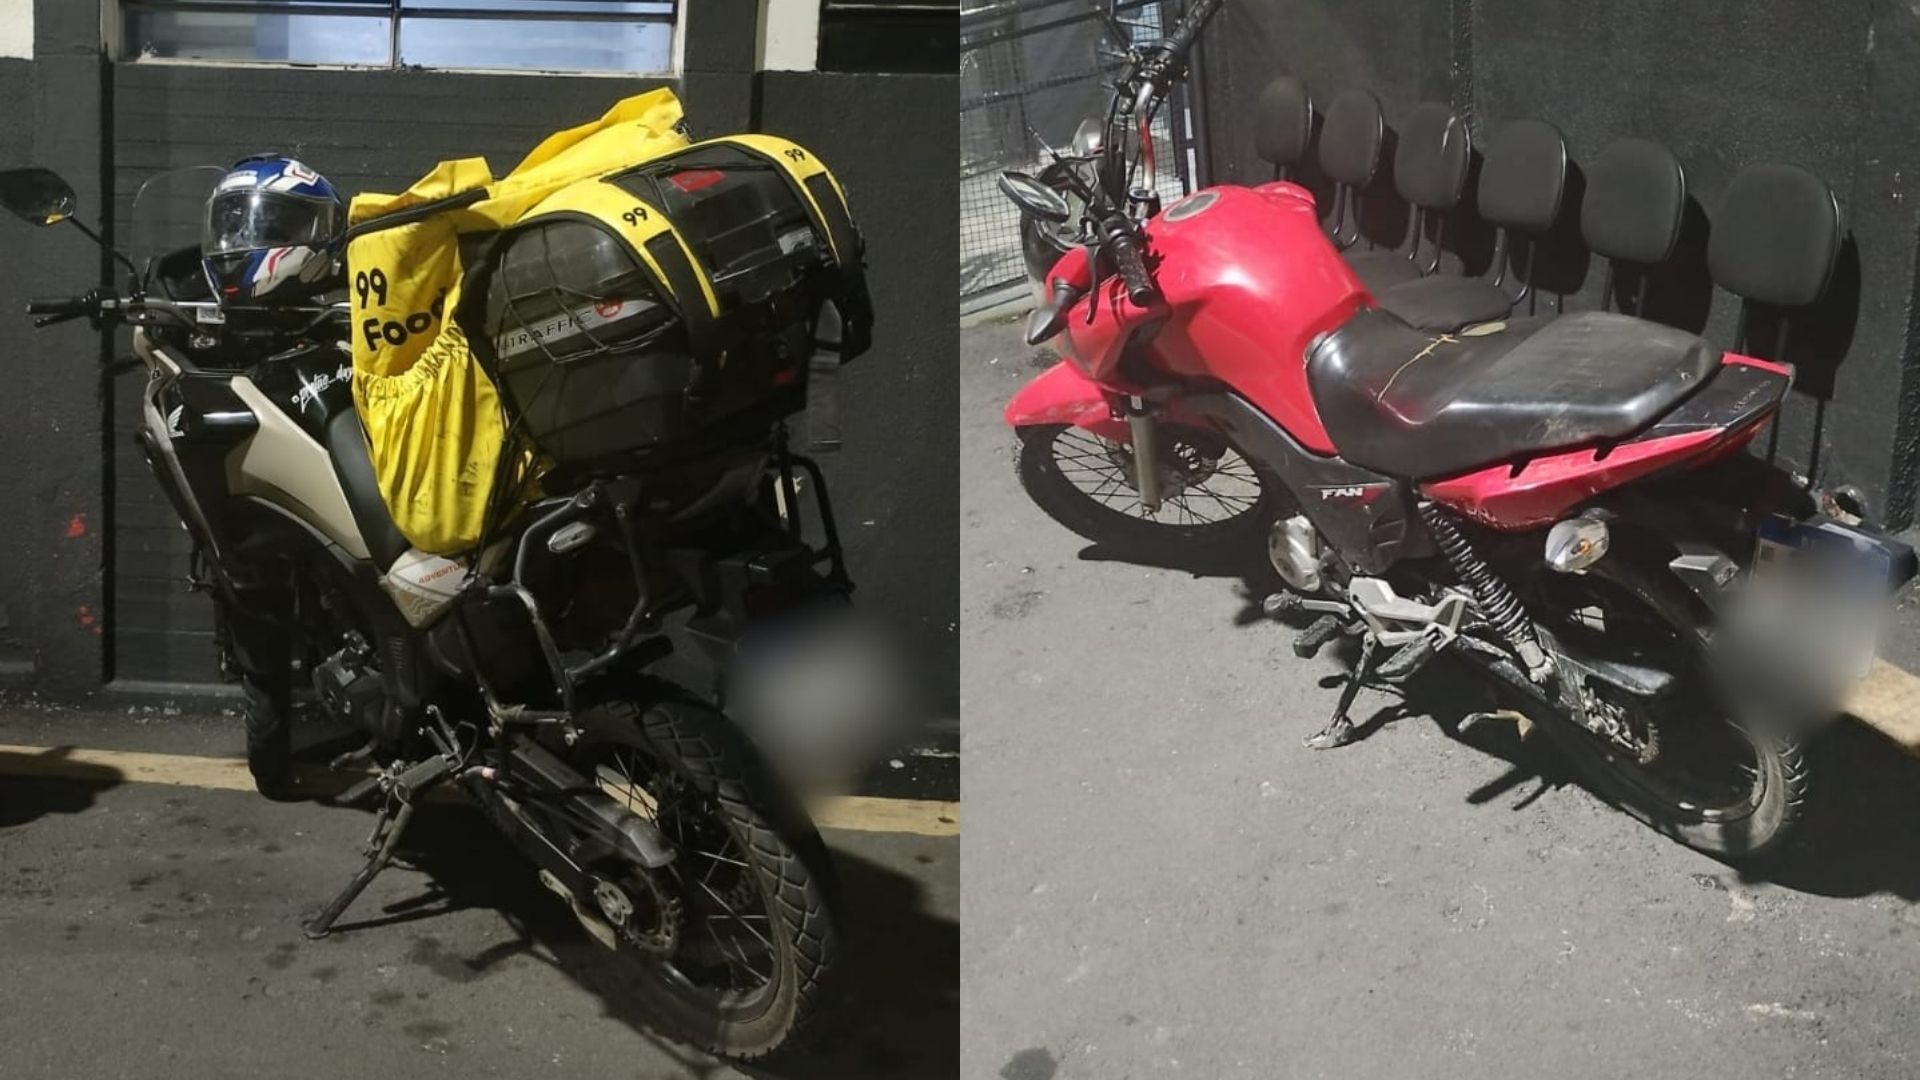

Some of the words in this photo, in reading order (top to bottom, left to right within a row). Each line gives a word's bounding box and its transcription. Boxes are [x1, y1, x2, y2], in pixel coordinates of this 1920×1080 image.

[784, 148, 805, 162] 99
[622, 207, 648, 227] 99
[356, 267, 387, 309] 99
[1321, 487, 1364, 500] FAN
